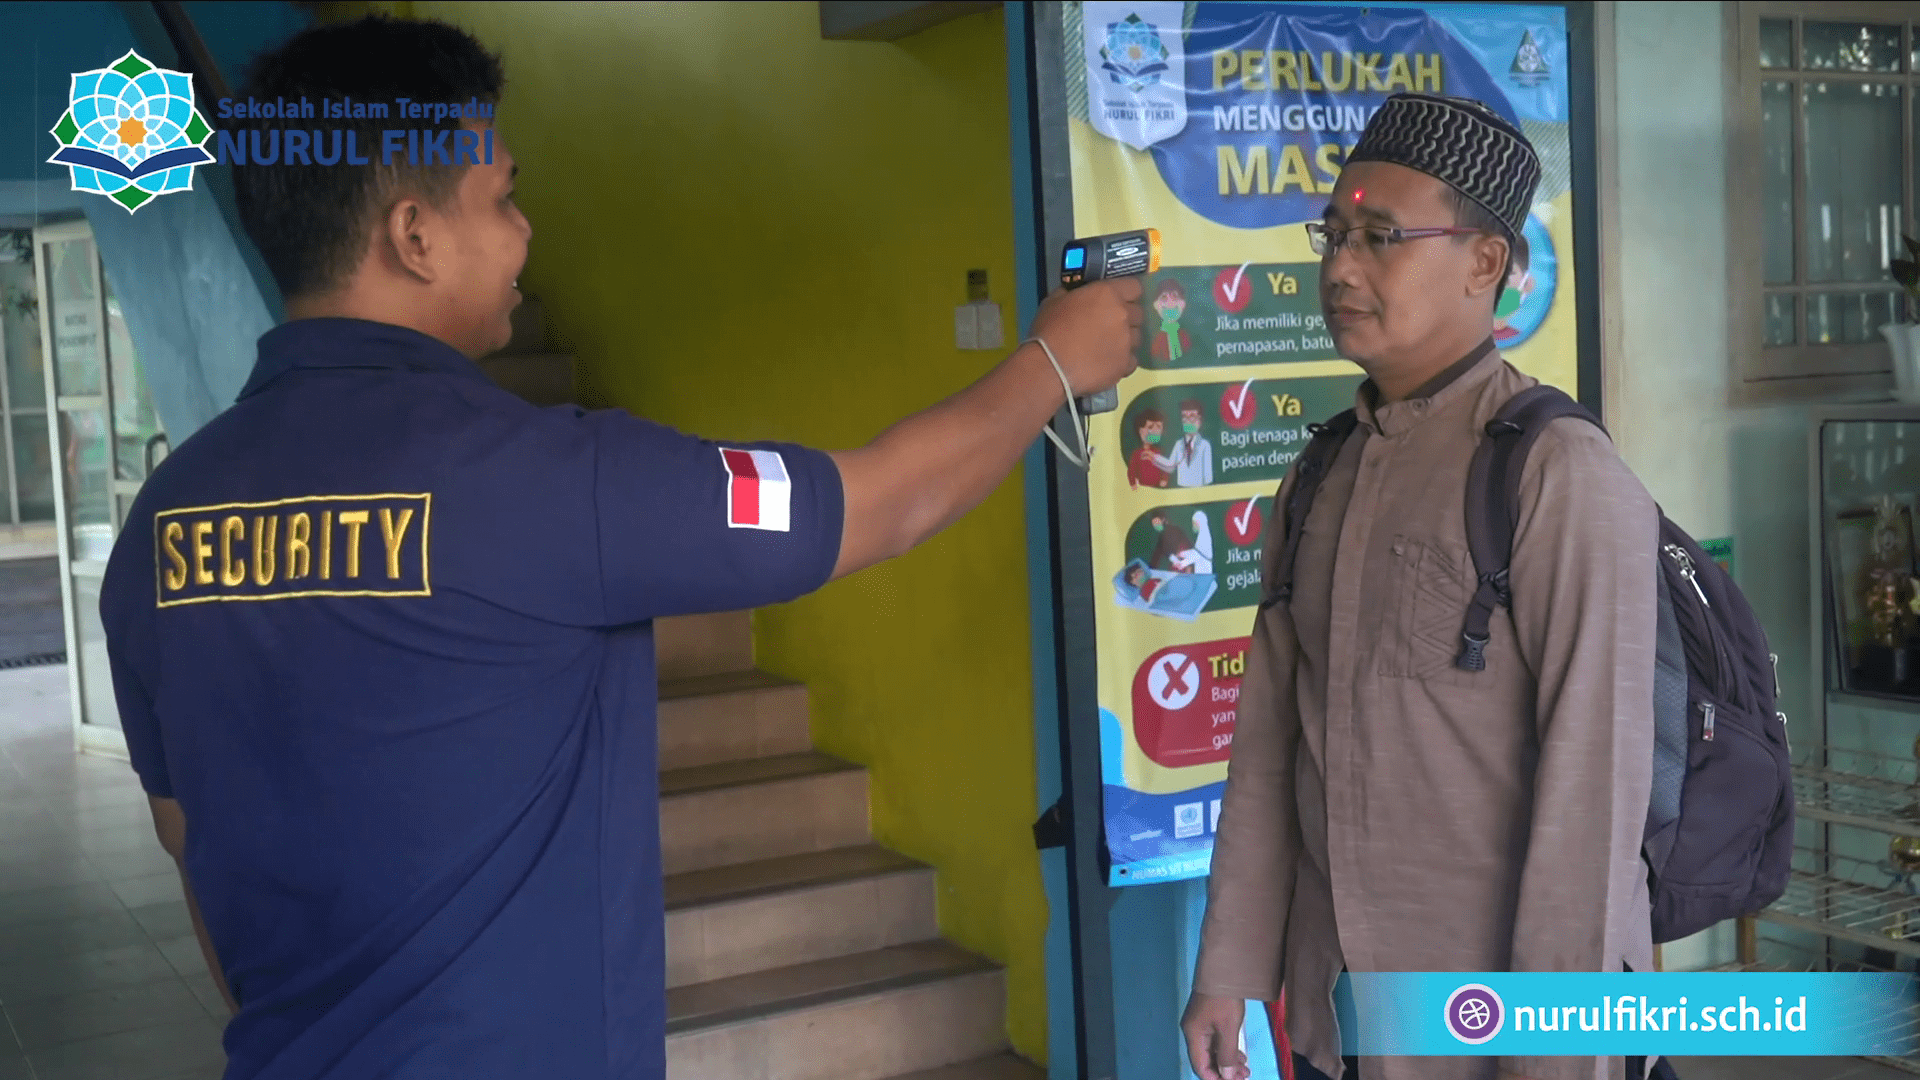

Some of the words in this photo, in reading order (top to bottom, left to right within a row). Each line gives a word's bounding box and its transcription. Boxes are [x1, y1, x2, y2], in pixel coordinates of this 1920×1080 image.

[1213, 51, 1442, 93] PERLUKAH
[1267, 271, 1298, 295] Ya
[1215, 314, 1240, 332] Jika
[1243, 312, 1302, 330] memiliki
[1216, 338, 1299, 358] pernapasan,
[1271, 393, 1301, 417] Ya
[1221, 430, 1250, 449] Bagi
[1253, 428, 1298, 445] tenaga
[1222, 453, 1265, 473] pasien
[162, 508, 414, 591] SECURITY
[1225, 547, 1250, 565] Jika
[1207, 650, 1244, 678] Tid
[1211, 683, 1240, 703] Bagi
